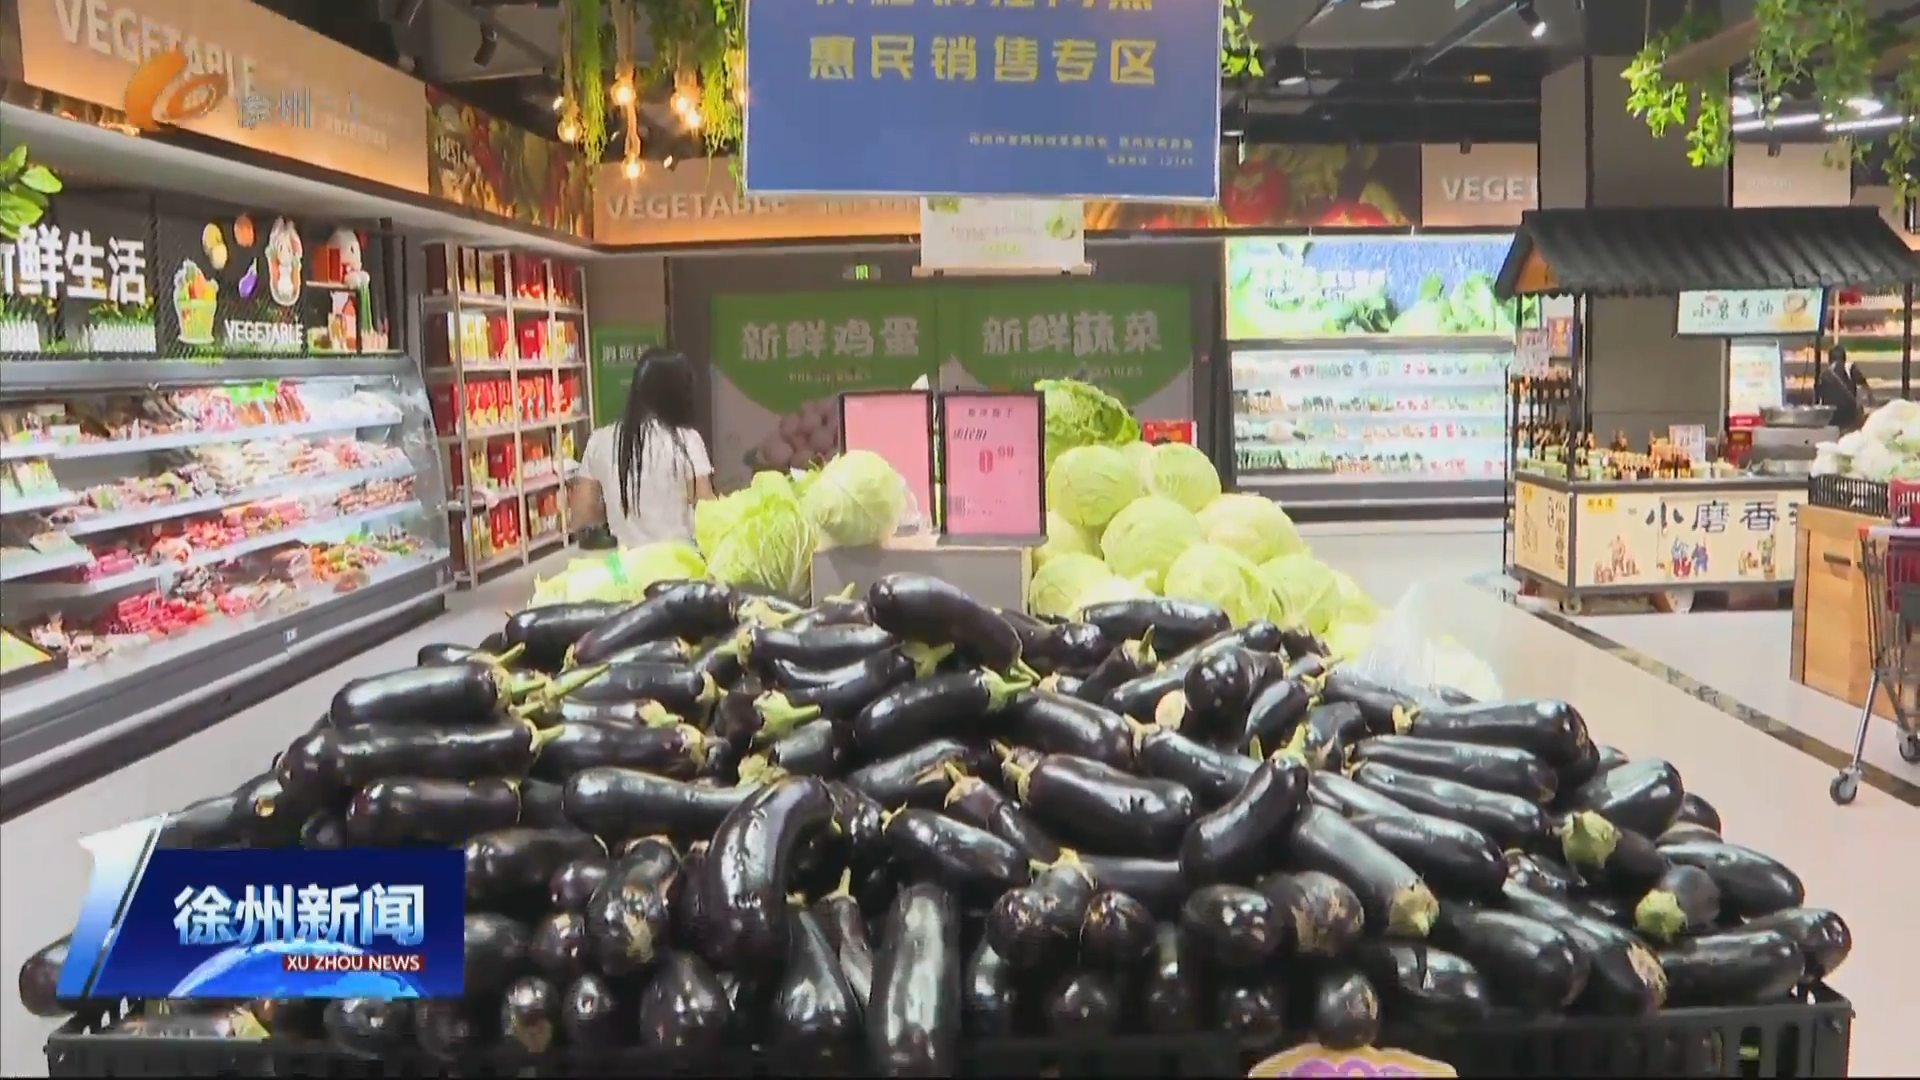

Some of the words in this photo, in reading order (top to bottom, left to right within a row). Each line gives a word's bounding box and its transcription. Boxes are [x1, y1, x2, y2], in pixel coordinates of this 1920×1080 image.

[809, 34, 1157, 85] 惠民销售专区
[224, 318, 304, 344] VEGETABLE
[741, 316, 920, 361] 新鲜鸡蛋
[982, 310, 1163, 357] 新鲜蔬菜
